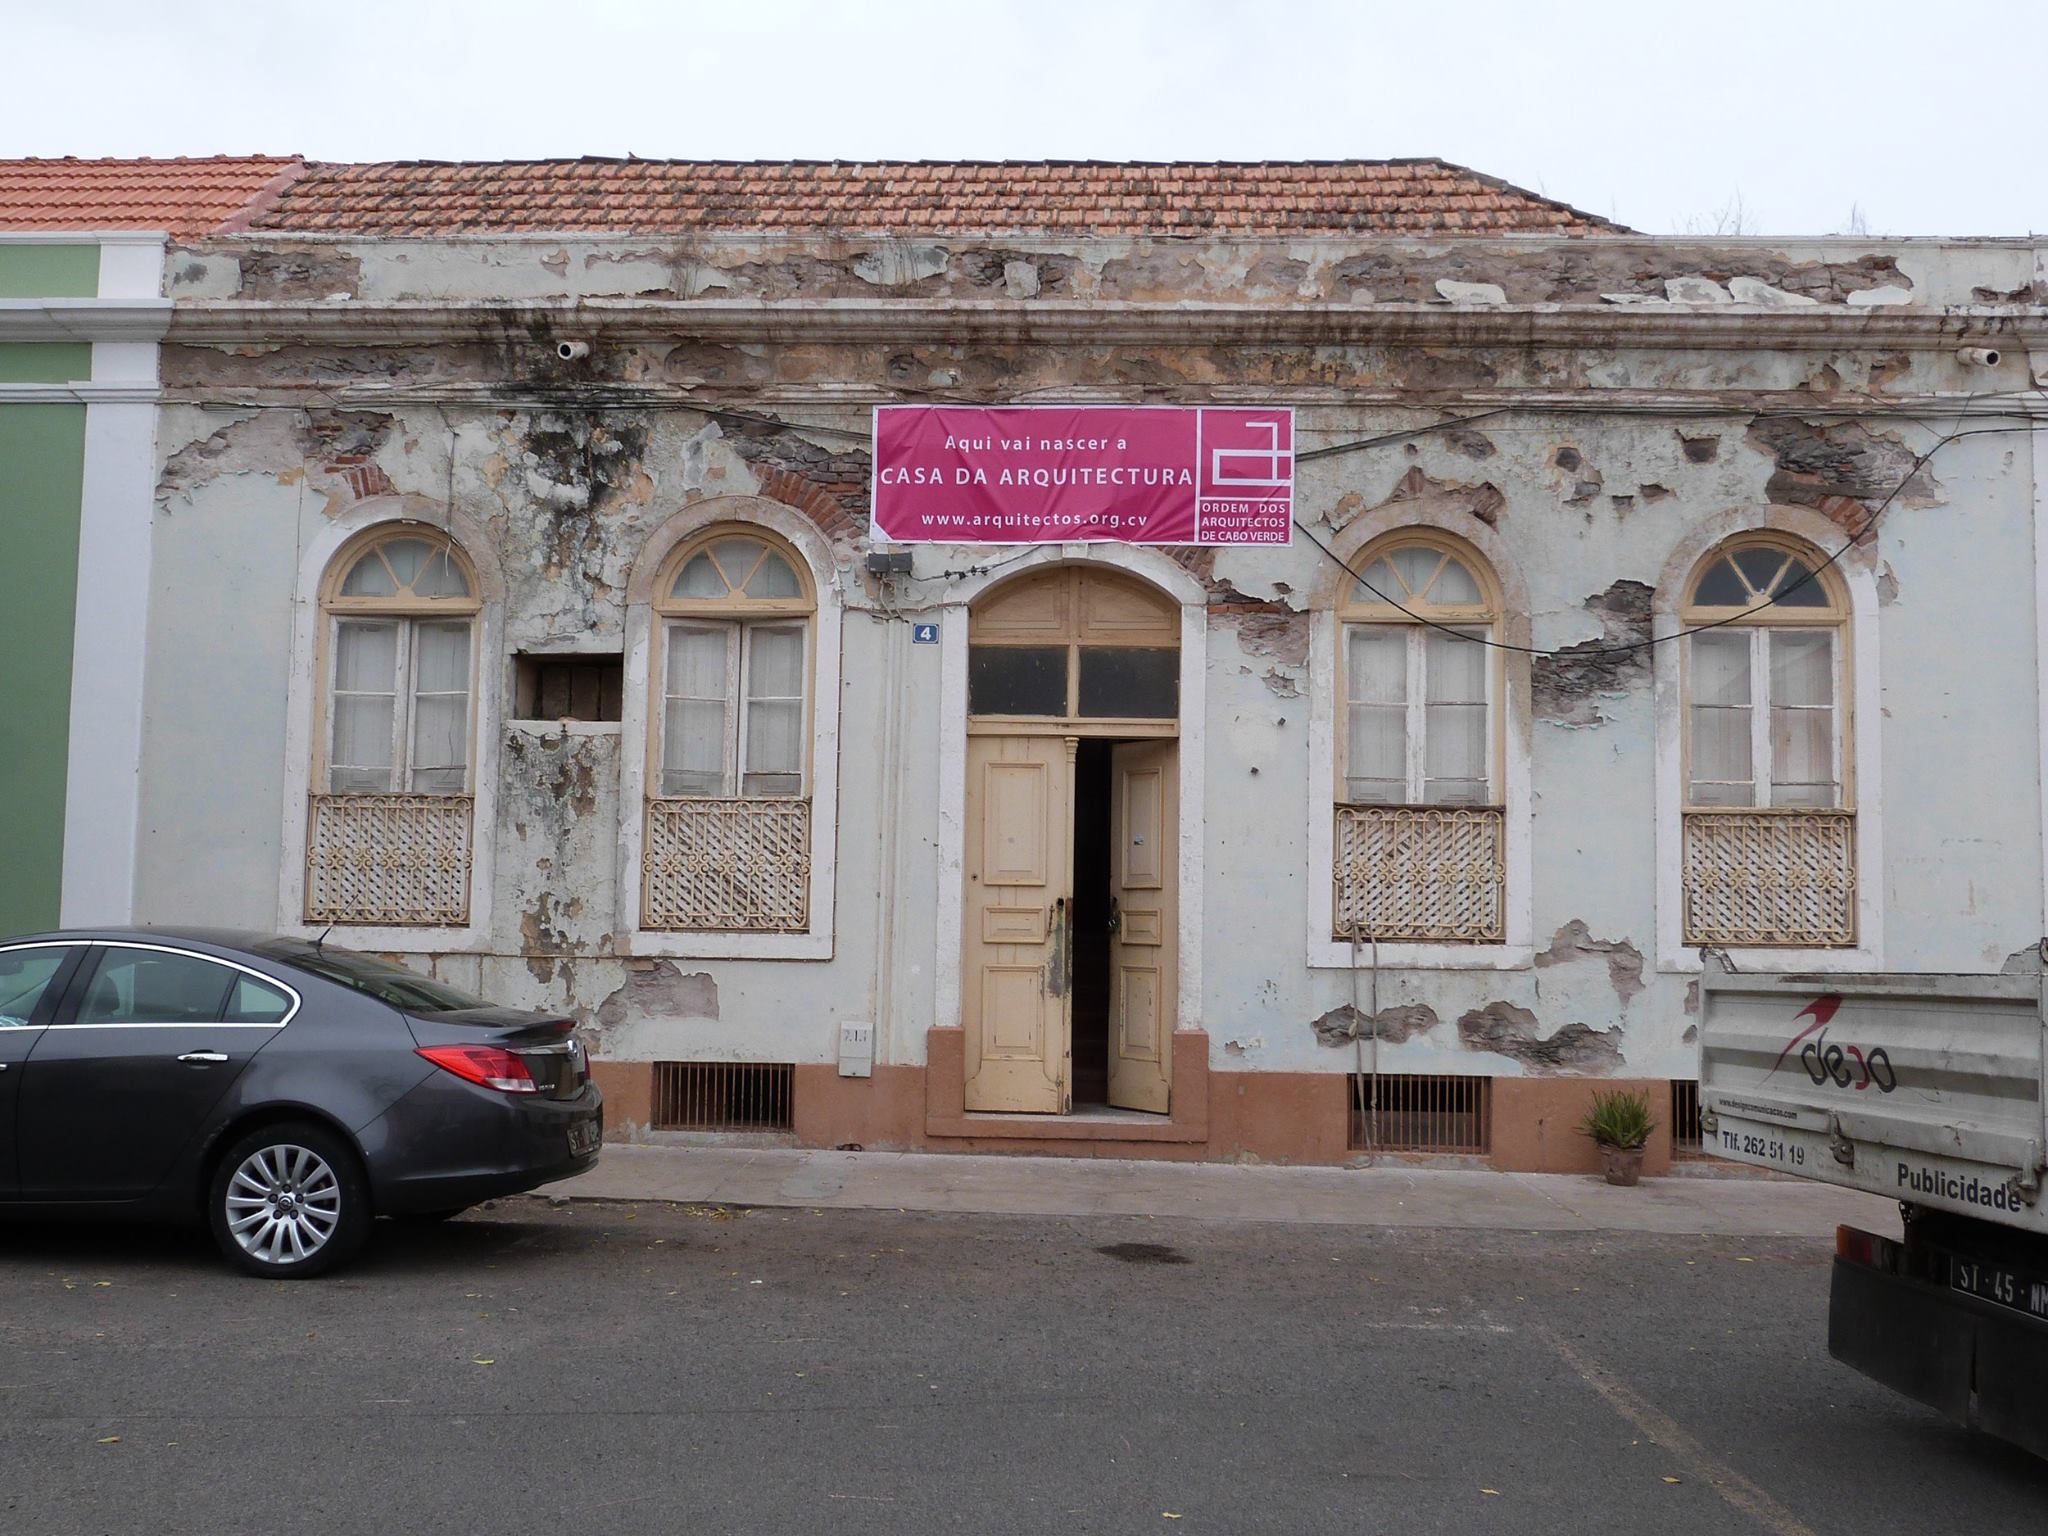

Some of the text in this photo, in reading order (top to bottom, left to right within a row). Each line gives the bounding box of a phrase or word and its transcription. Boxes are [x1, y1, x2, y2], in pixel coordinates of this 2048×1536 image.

[944, 435, 1127, 453] Aqui vai nascer a
[880, 467, 1193, 487] CASA DA ARQUITECTURA
[1202, 503, 1286, 514] ORDEM DOS
[922, 512, 1148, 529] www.arquitectos.org.cv
[1201, 516, 1286, 528] ARQUITECTOS
[1201, 531, 1285, 542] DE CABO VERDE
[920, 626, 932, 641] 4
[1722, 1130, 1740, 1152] Tlf.
[1743, 1135, 1766, 1157] 262
[1769, 1140, 1784, 1161] 51
[1789, 1144, 1805, 1166] 19
[1897, 1162, 2022, 1213] Publicidade
